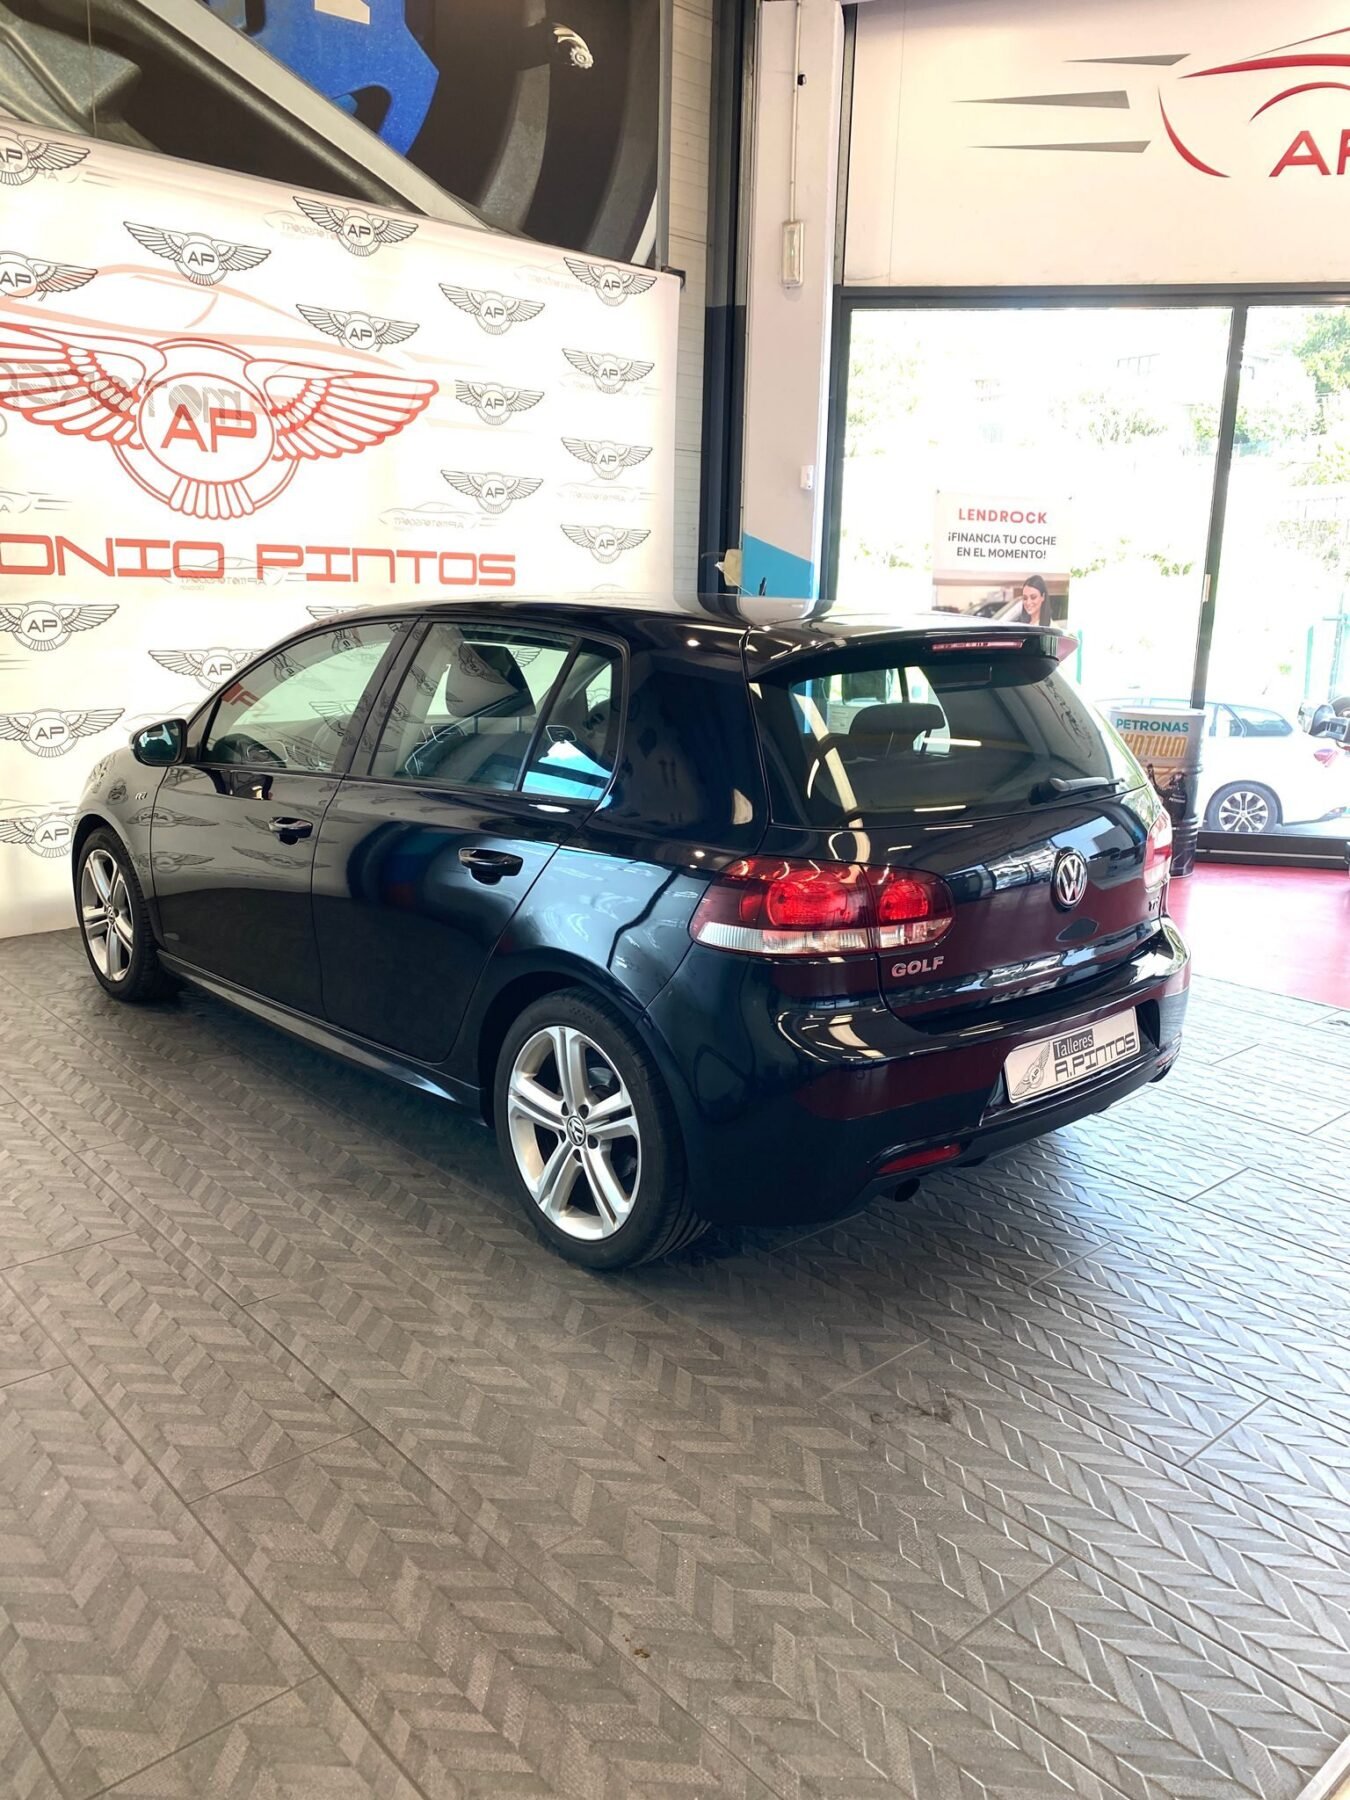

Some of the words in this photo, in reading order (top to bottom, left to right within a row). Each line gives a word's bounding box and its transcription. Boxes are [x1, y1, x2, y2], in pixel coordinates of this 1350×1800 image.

[348, 224, 371, 238] AP
[188, 252, 215, 266] AP
[0, 271, 32, 288] AP
[603, 279, 621, 289] AP
[484, 306, 505, 318] AP
[350, 328, 373, 341] AP
[601, 368, 619, 378] AP
[485, 397, 505, 409] AP
[161, 404, 257, 453] AP
[600, 454, 617, 465] AP
[486, 487, 505, 498] AP
[959, 508, 1047, 524] LENDROCK
[598, 539, 615, 549] AP
[948, 531, 1001, 544] ¡FINANCIA
[1003, 534, 1017, 545] TU
[1019, 535, 1057, 546] COCHE
[956, 546, 971, 557] EN
[973, 547, 986, 558] EL
[988, 548, 1047, 560] MOMENTO!
[256, 543, 516, 587] PINTOS
[27, 619, 58, 633] AP
[207, 662, 233, 676] AP
[1116, 718, 1190, 733] PETRONAS
[35, 726, 65, 741] AP
[1120, 732, 1188, 757] YNTIUM
[40, 827, 70, 843] AP
[891, 955, 945, 978] GOLF
[1054, 1034, 1094, 1058] Talleres
